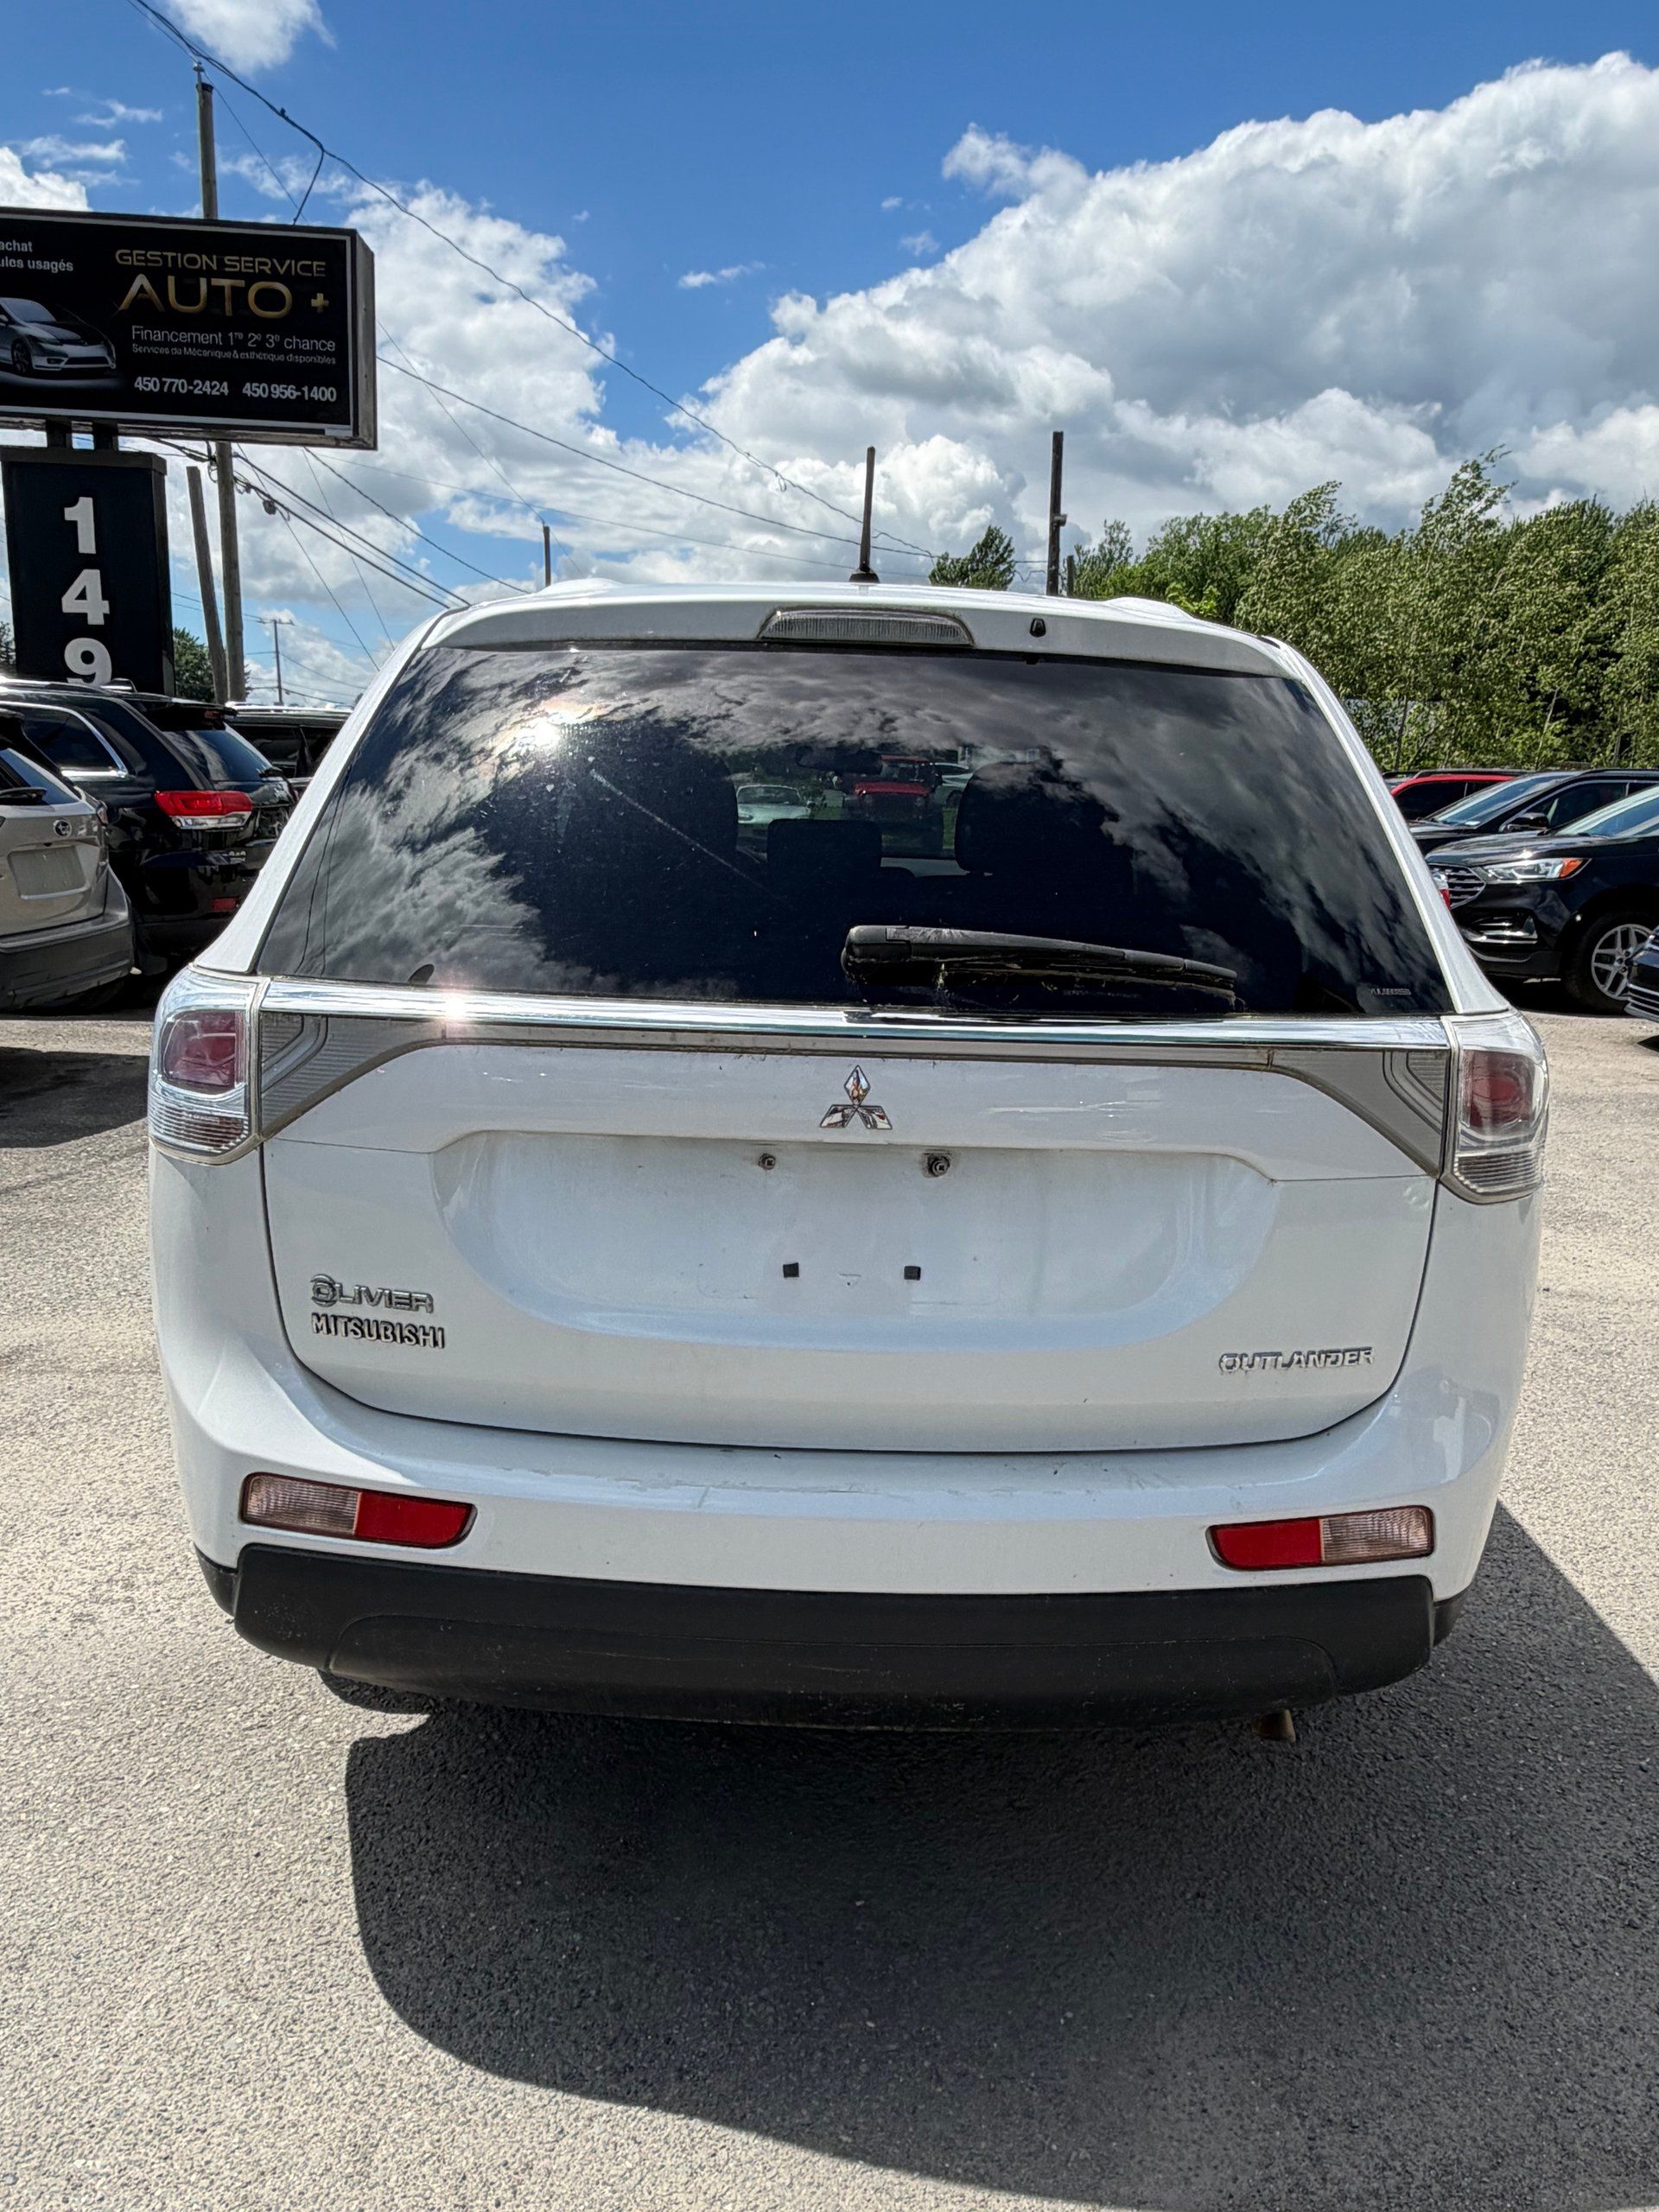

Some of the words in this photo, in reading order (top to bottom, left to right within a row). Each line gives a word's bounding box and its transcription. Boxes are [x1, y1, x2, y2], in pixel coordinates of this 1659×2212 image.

[27, 258, 74, 274] usagés
[115, 249, 217, 270] GESTION
[224, 256, 327, 277] SERVICE
[118, 273, 293, 319] AUTO
[131, 325, 223, 346] Financement
[283, 335, 335, 352] chance
[132, 343, 170, 356] Services
[232, 349, 239, 359] &
[286, 353, 336, 365] disponibles
[134, 376, 160, 392] 450
[162, 378, 229, 396] 770-2424
[243, 382, 269, 398] 450
[270, 384, 337, 403] 956-1400
[310, 1274, 435, 1314] OLIVIER
[311, 1313, 445, 1350] MITSUBISHI
[1219, 1346, 1376, 1373] OUTLANDER
